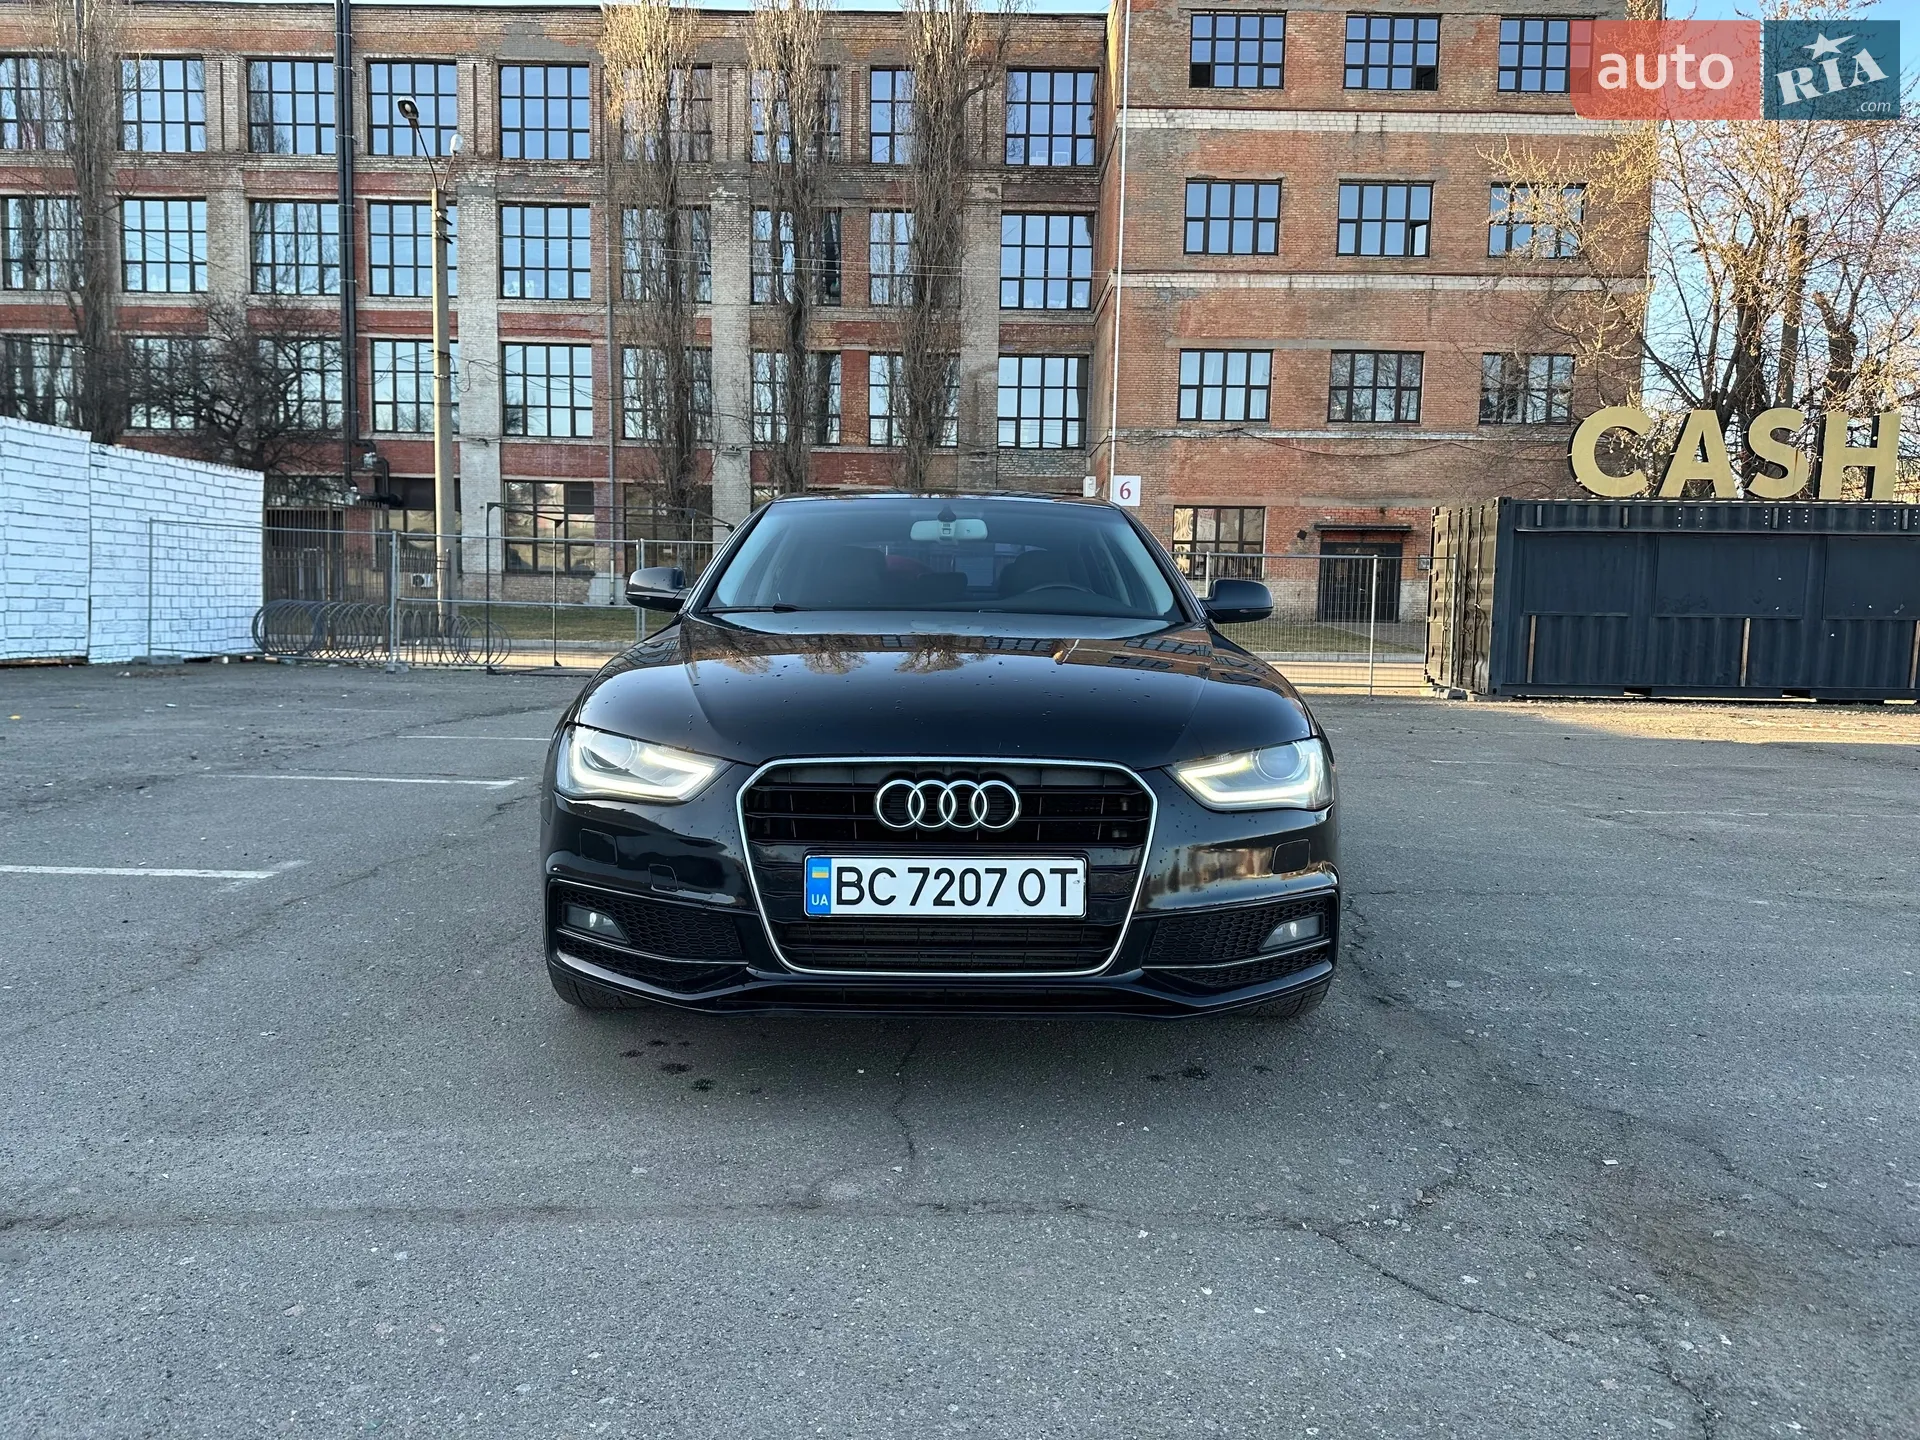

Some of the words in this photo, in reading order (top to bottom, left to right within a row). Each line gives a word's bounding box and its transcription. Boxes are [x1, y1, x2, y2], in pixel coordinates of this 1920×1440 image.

[1568, 406, 1901, 501] CASH
[1120, 481, 1131, 500] 6
[811, 894, 829, 906] UA
[836, 866, 897, 906] BC
[907, 867, 1007, 907] 7207
[1018, 867, 1078, 907] OT
